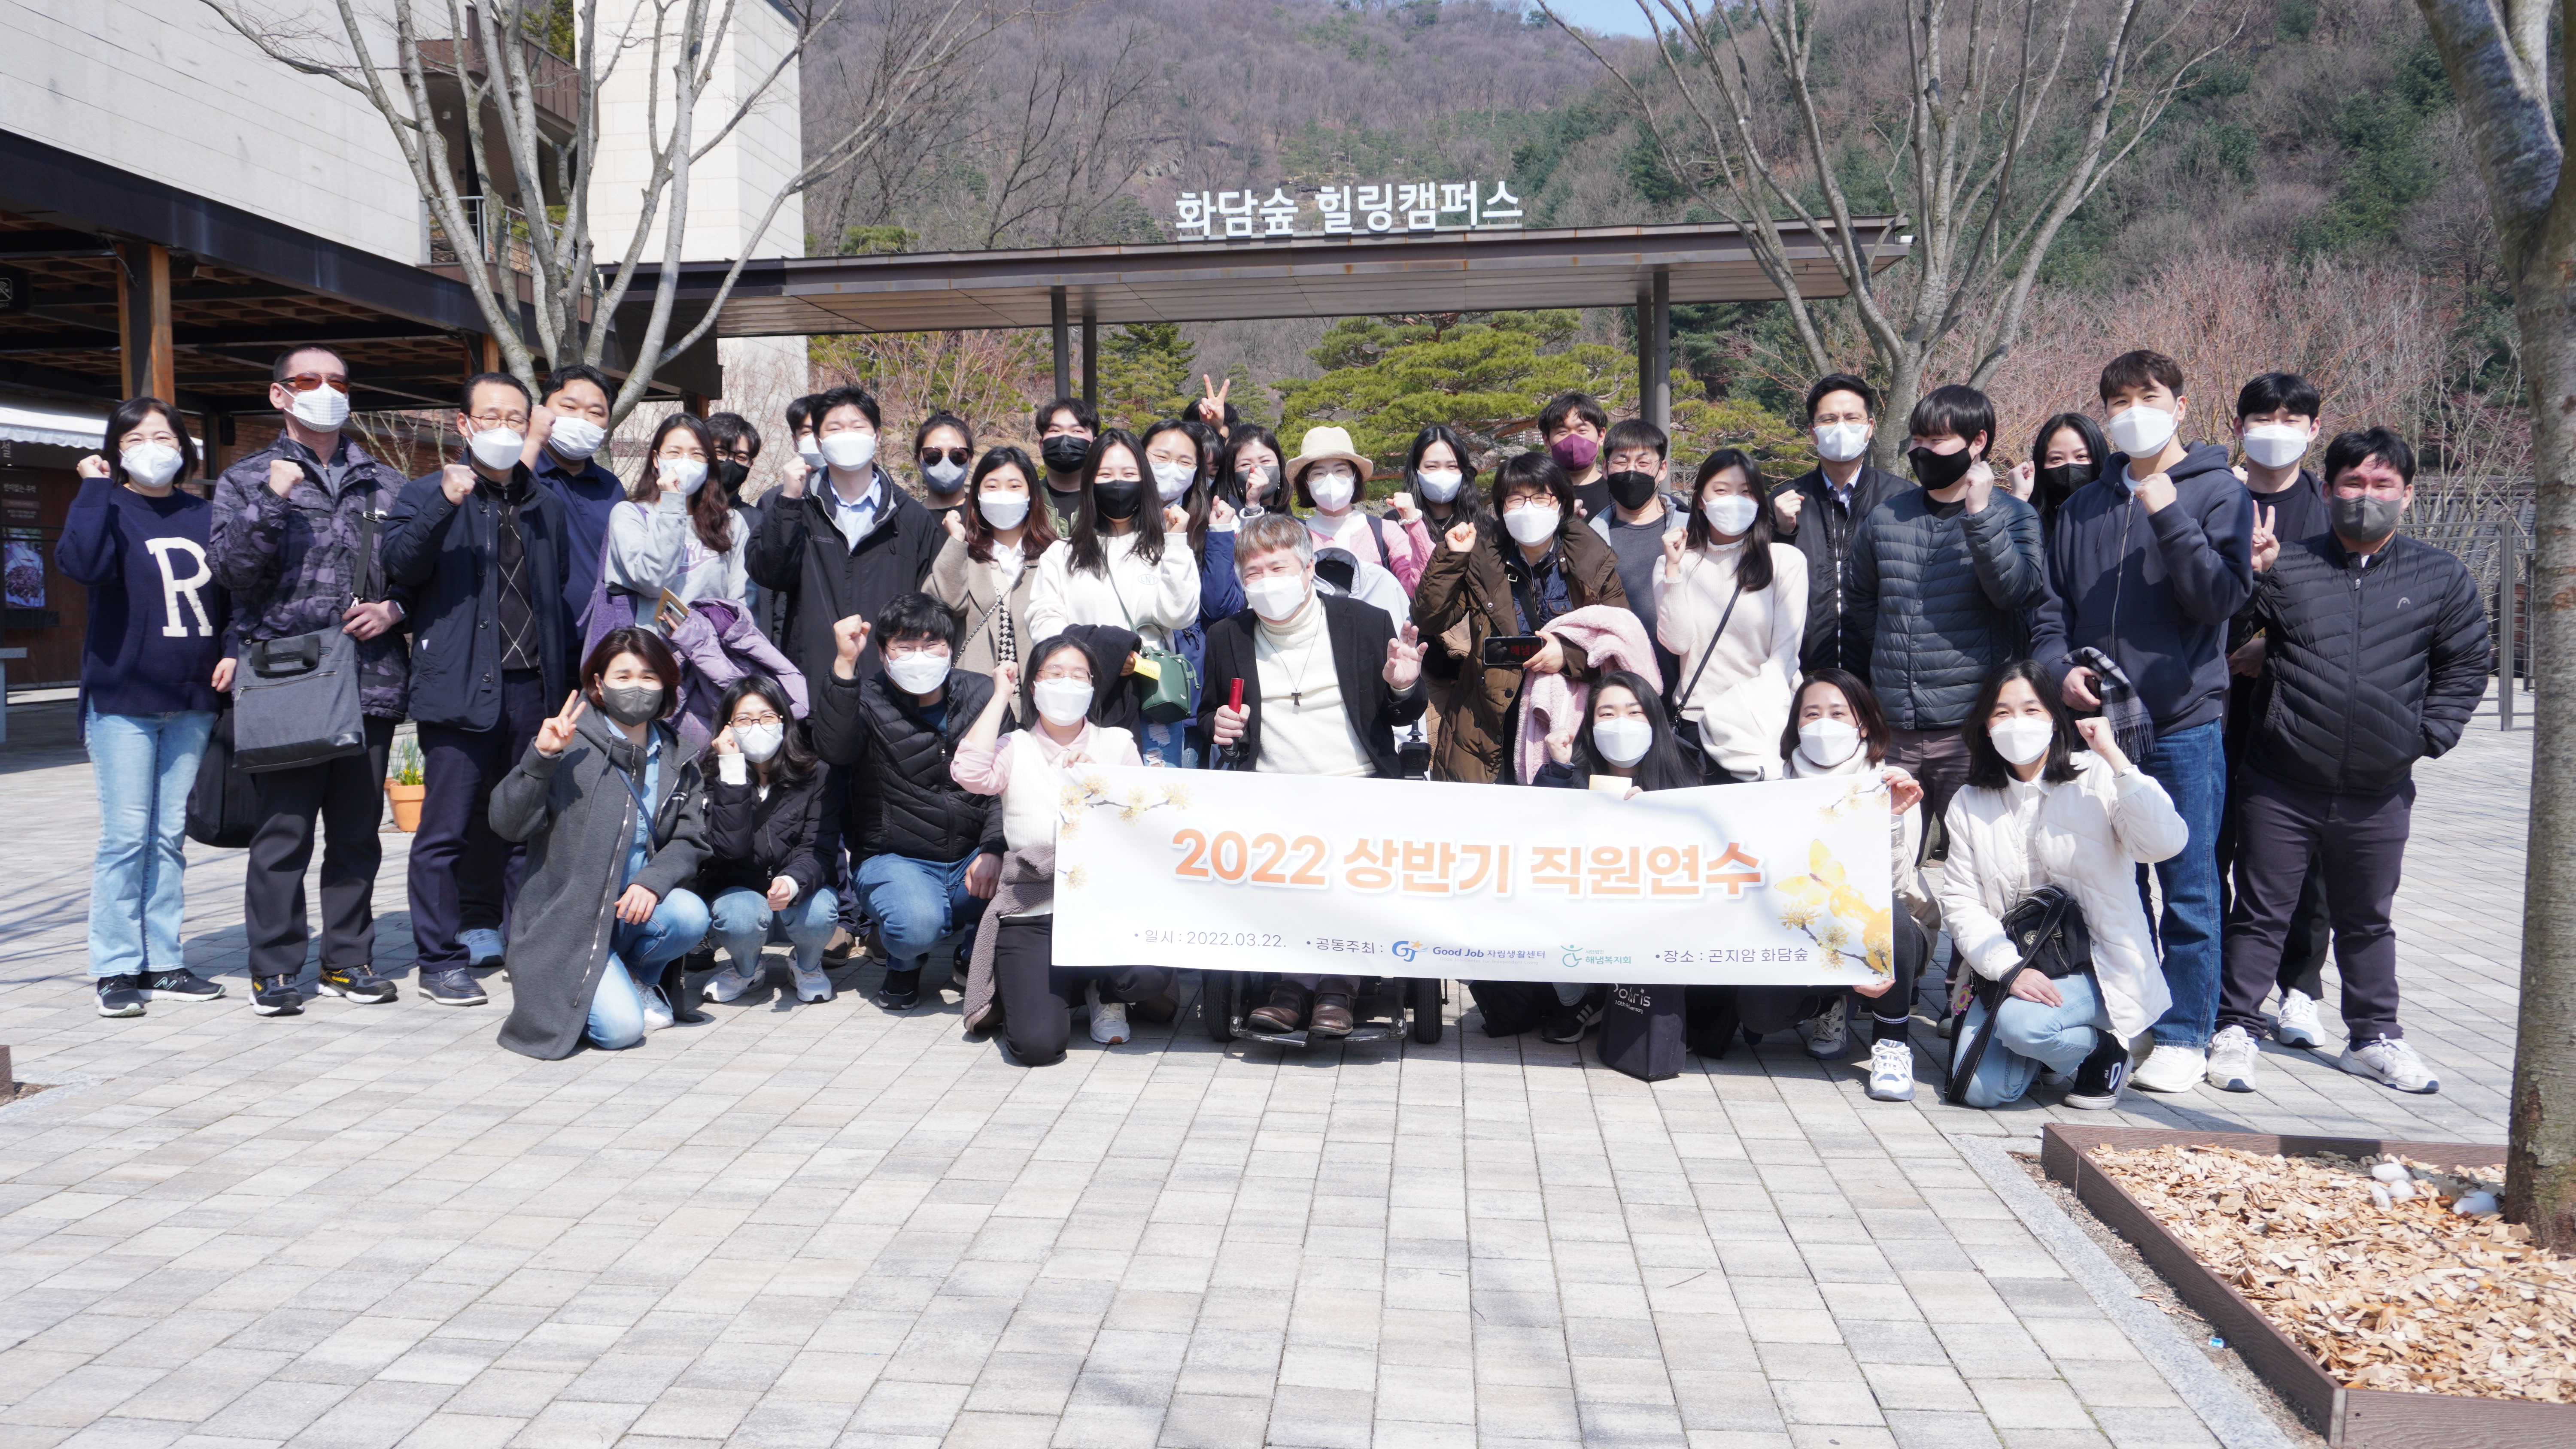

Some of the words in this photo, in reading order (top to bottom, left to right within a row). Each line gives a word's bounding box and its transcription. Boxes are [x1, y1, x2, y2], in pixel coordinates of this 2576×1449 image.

[1176, 188, 1299, 236] 화담숲
[1315, 180, 1523, 234] 힐링캠퍼스
[145, 537, 213, 637] R
[1173, 828, 1326, 885] 2022
[1343, 838, 1510, 893] 상반기
[1530, 842, 1761, 895] 직원연수
[1145, 930, 1173, 943] 일시
[1187, 931, 1286, 947] 2022.03.22.
[1316, 938, 1374, 954] 공동주최
[1432, 946, 1462, 956] Good
[1464, 949, 1484, 958] Job
[1486, 949, 1545, 959] 자립생활센터
[1585, 955, 1631, 965] 해냄복지회
[1664, 950, 1695, 963] 장소
[1708, 949, 1756, 963] 곤지암
[1761, 947, 1808, 962] 화담숲
